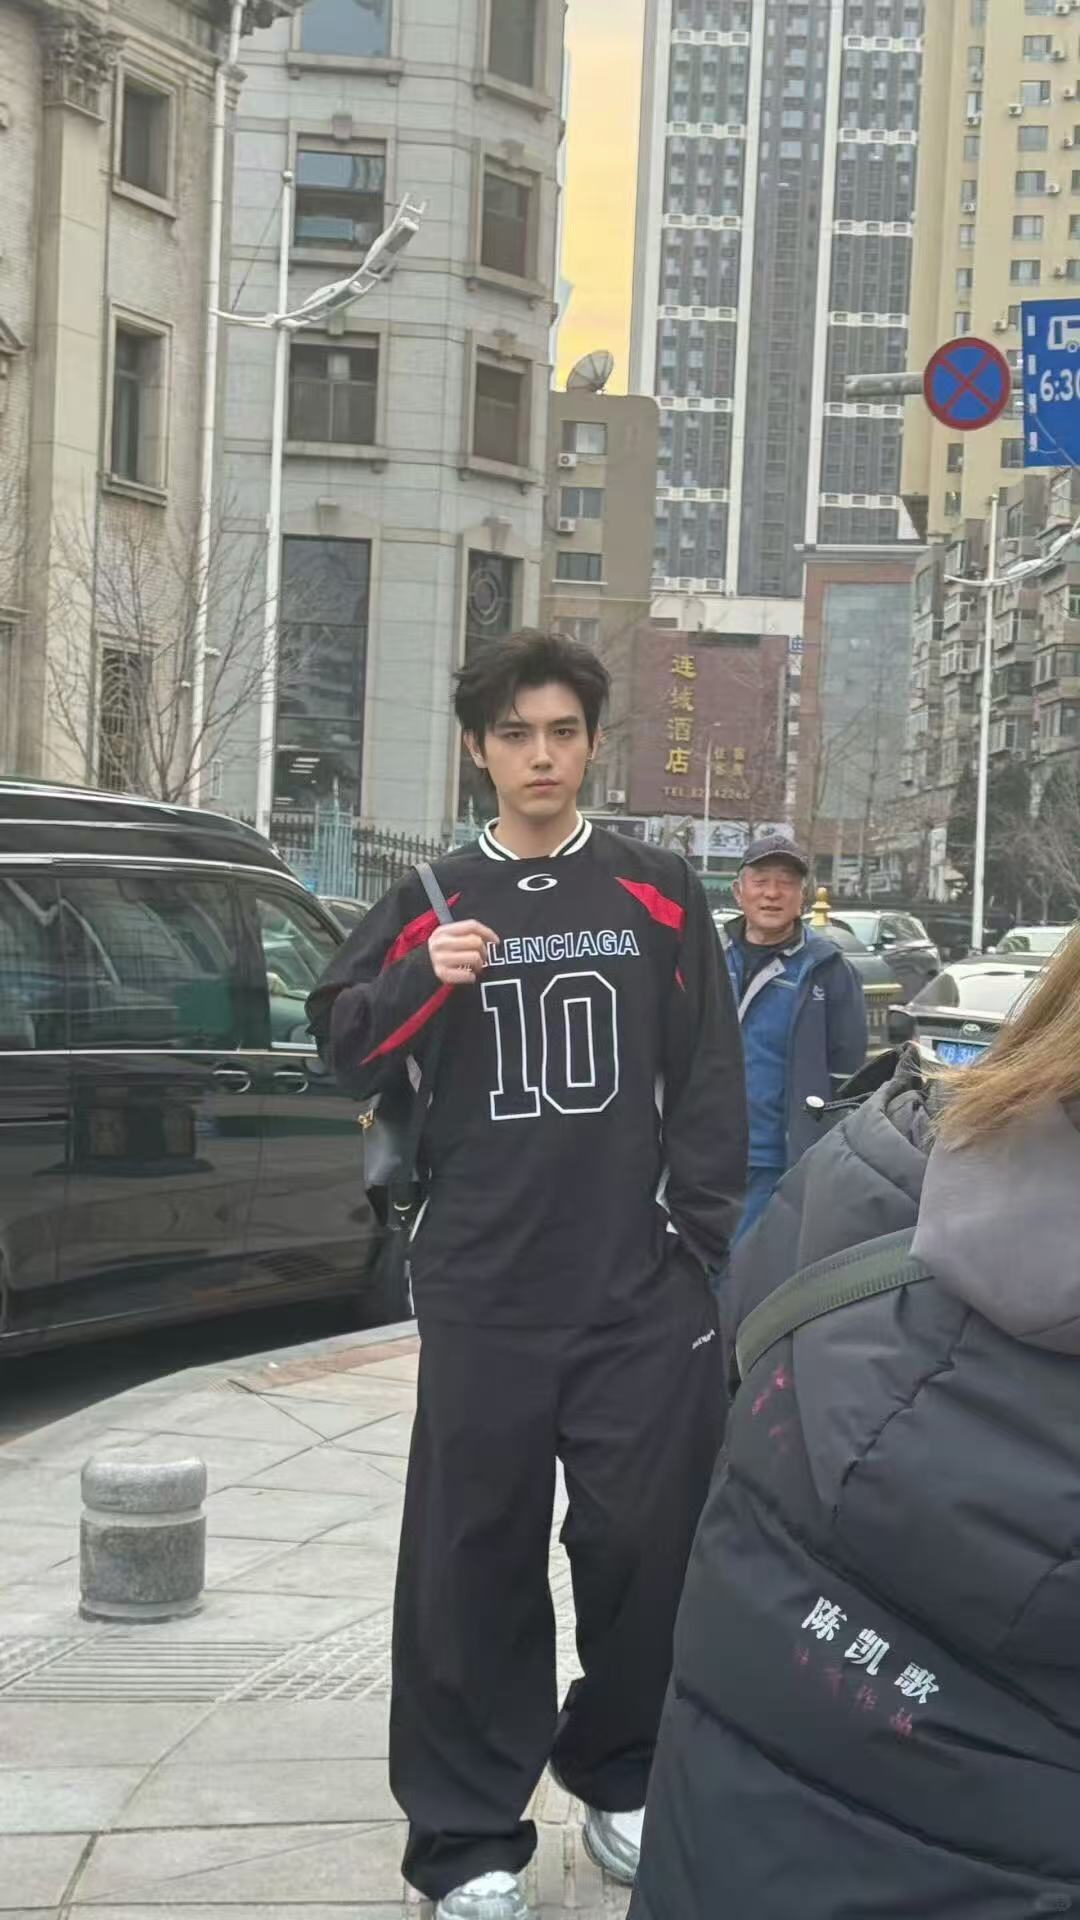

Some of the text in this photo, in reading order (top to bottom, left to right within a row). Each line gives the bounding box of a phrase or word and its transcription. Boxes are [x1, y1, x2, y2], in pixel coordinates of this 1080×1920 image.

[481, 930, 640, 968] LENCIAGA
[480, 971, 619, 1120] 10
[801, 1596, 939, 1704] 陈凯歌
